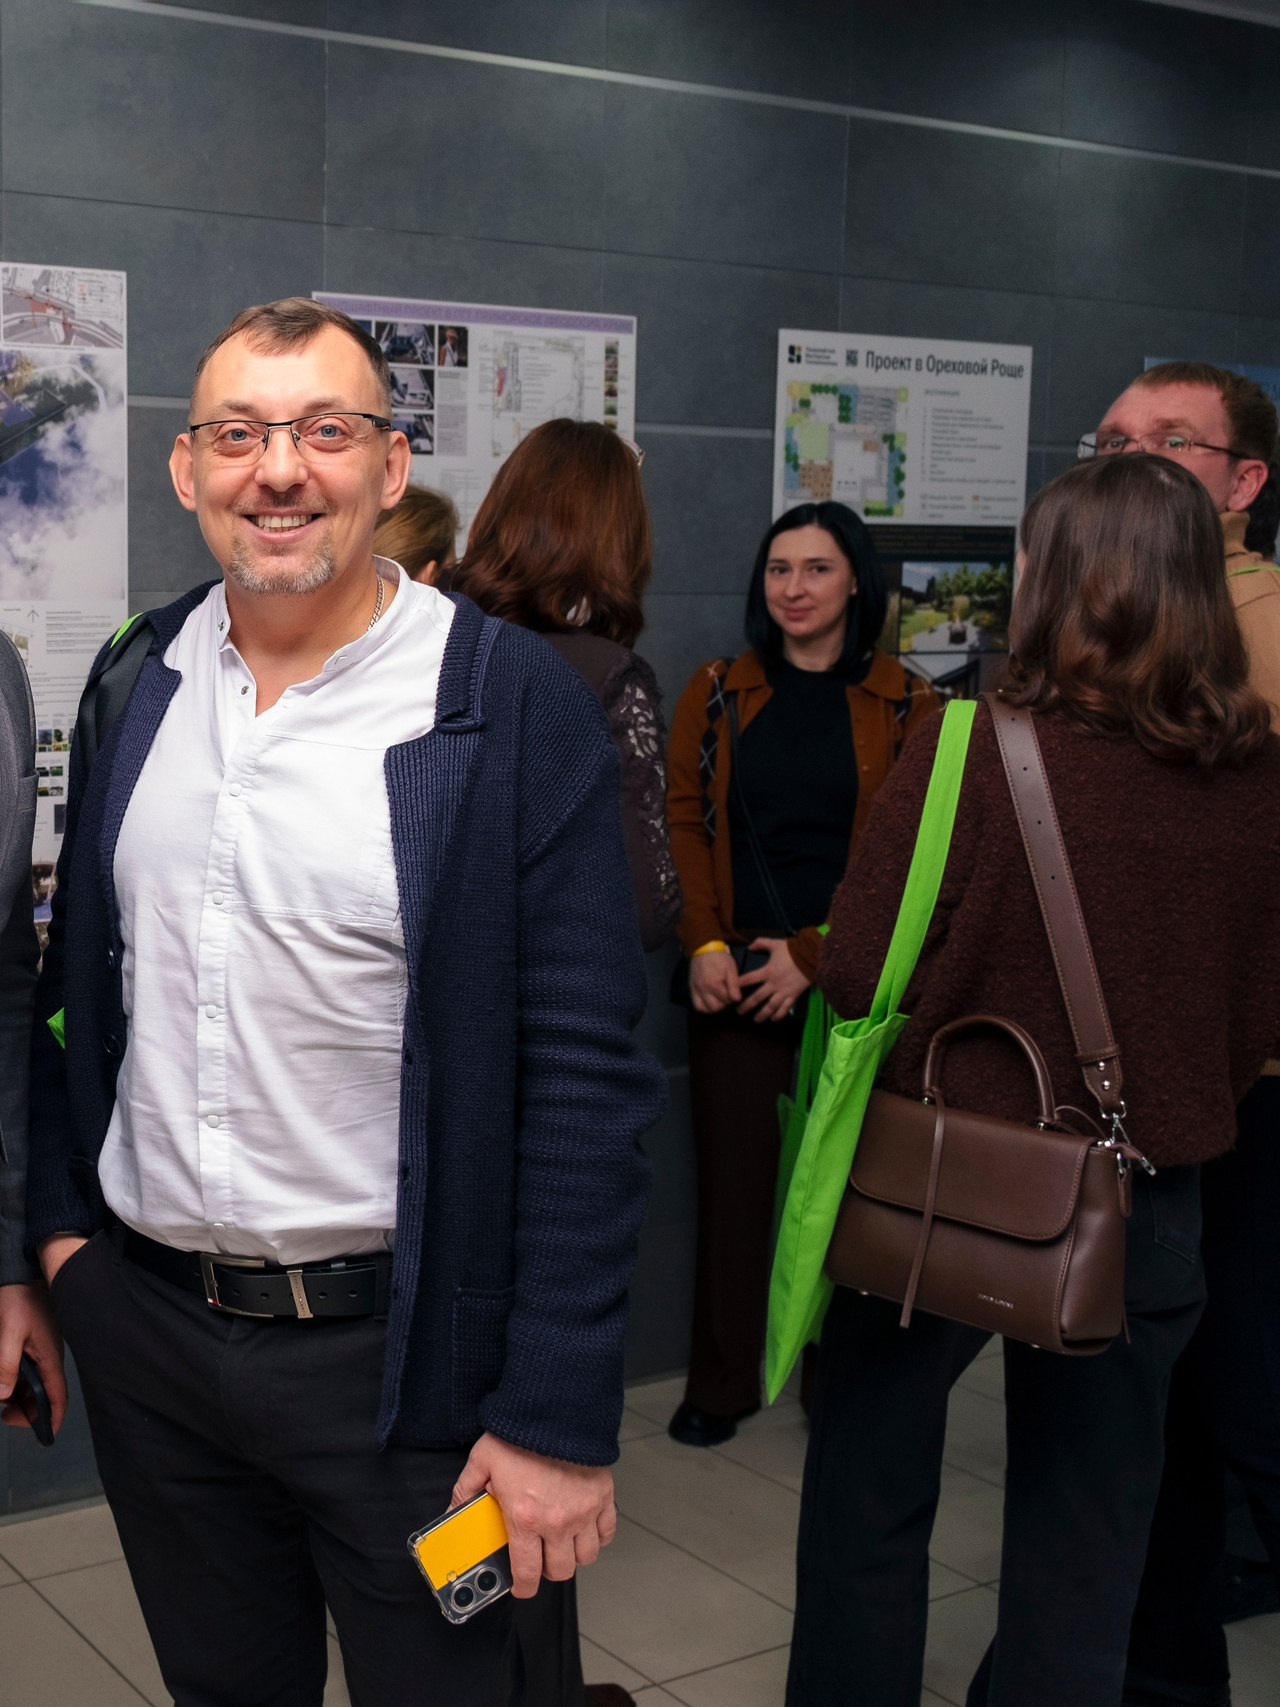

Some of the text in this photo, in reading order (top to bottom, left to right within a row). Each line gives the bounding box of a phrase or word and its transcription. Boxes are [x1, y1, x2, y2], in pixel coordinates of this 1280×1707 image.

[866, 351, 1025, 378] Проект в Ореховой Роще
